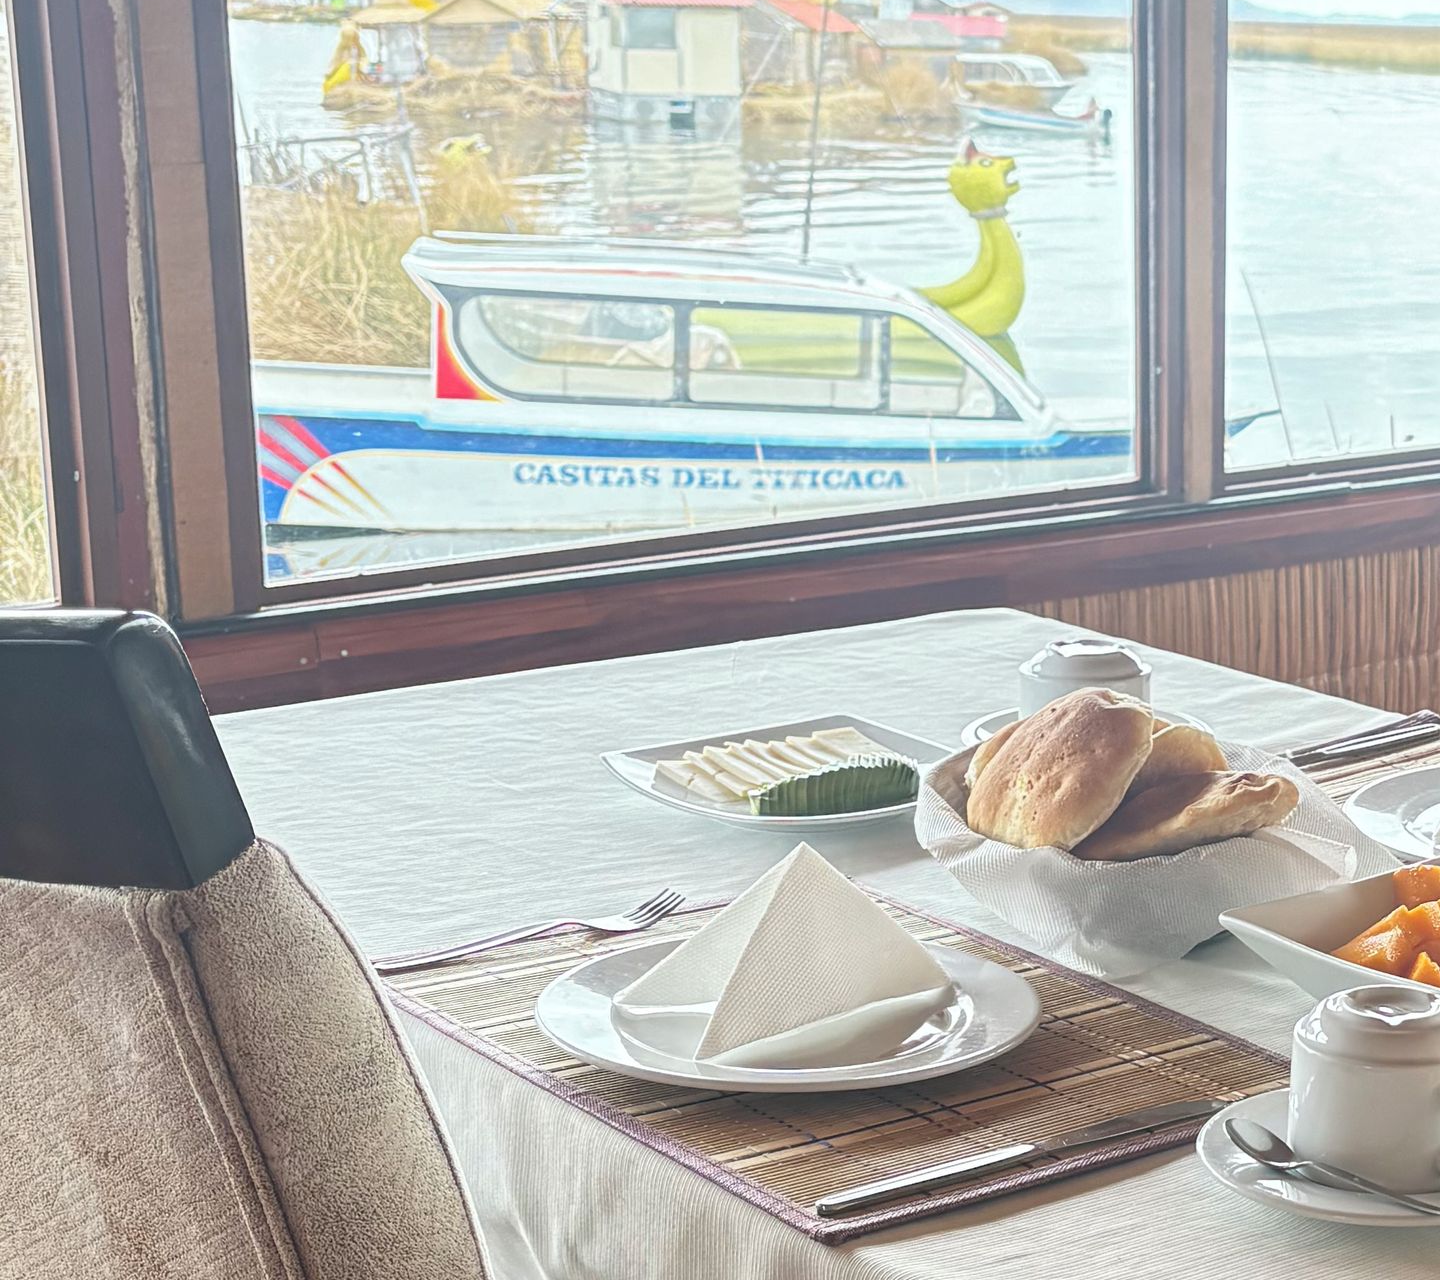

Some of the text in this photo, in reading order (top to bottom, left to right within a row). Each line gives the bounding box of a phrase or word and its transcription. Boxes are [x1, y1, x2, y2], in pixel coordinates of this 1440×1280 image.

[514, 462, 907, 491] CASITAS DEL TITICACA
